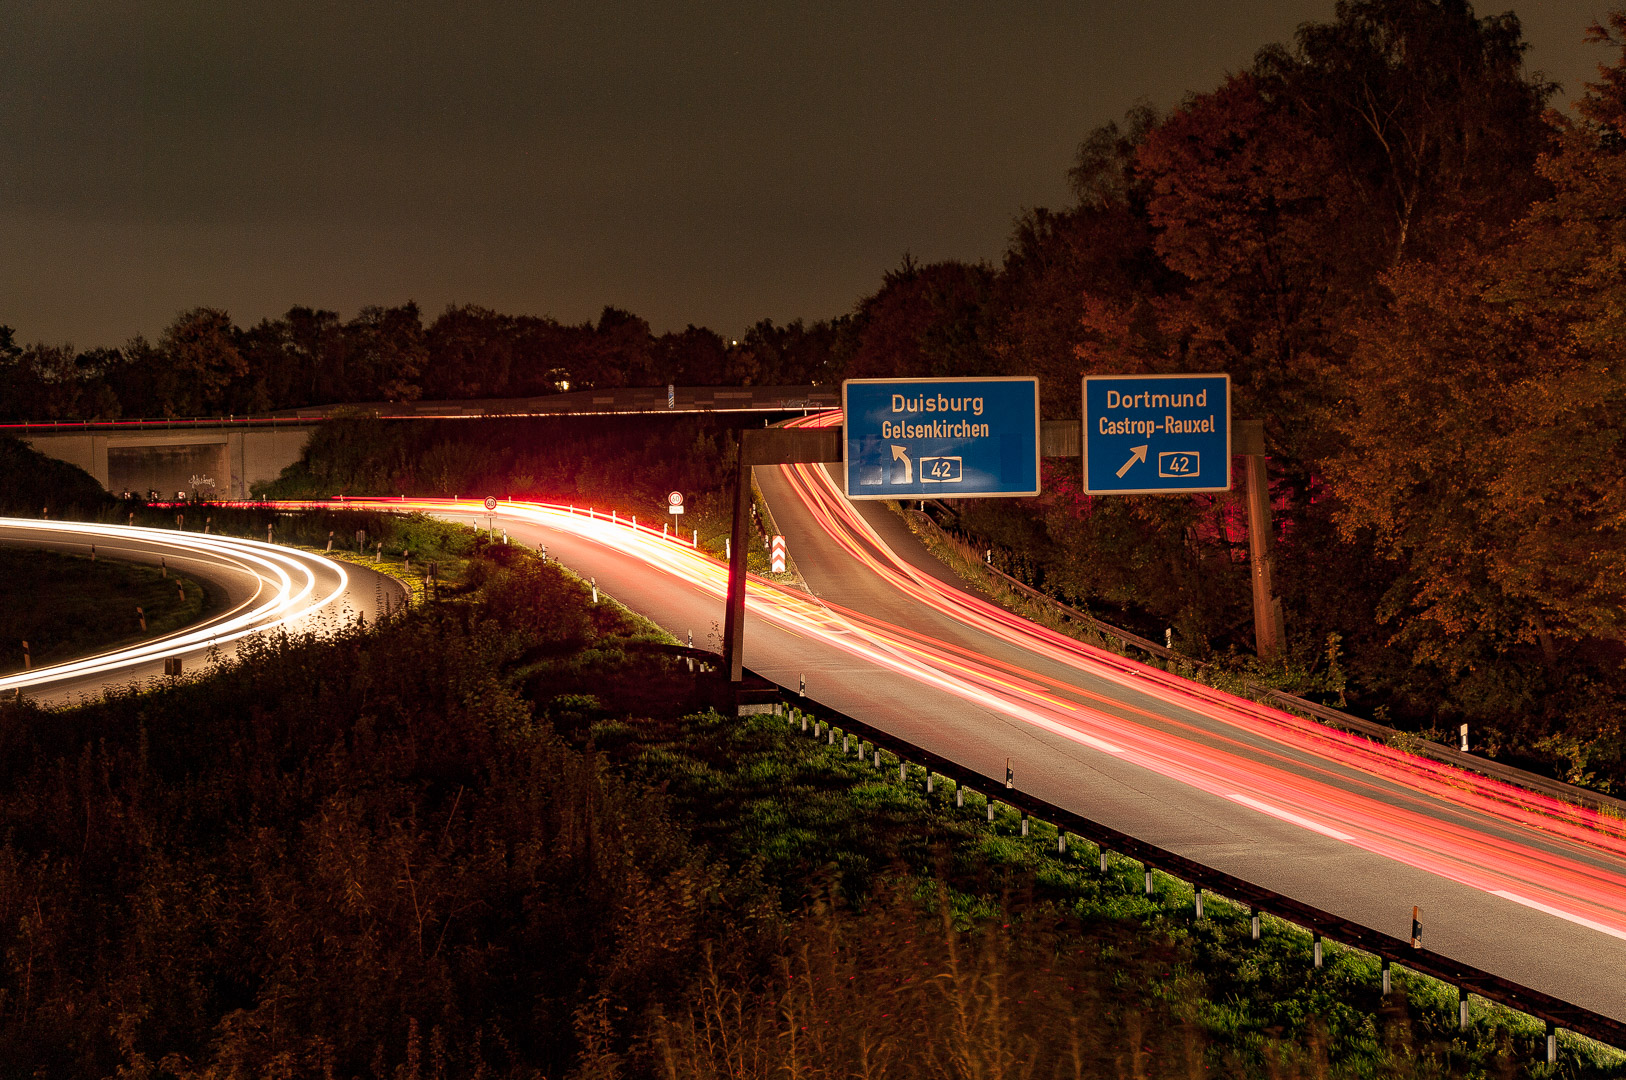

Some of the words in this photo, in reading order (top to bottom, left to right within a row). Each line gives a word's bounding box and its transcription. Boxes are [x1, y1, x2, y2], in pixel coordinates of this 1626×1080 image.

[892, 393, 984, 415] Duisburg
[1107, 388, 1207, 410] Dortmund
[882, 419, 990, 439] Gelsenkirchen
[1099, 414, 1215, 438] Castrop-Rauxel
[930, 461, 951, 478] 42
[1169, 455, 1189, 472] 42
